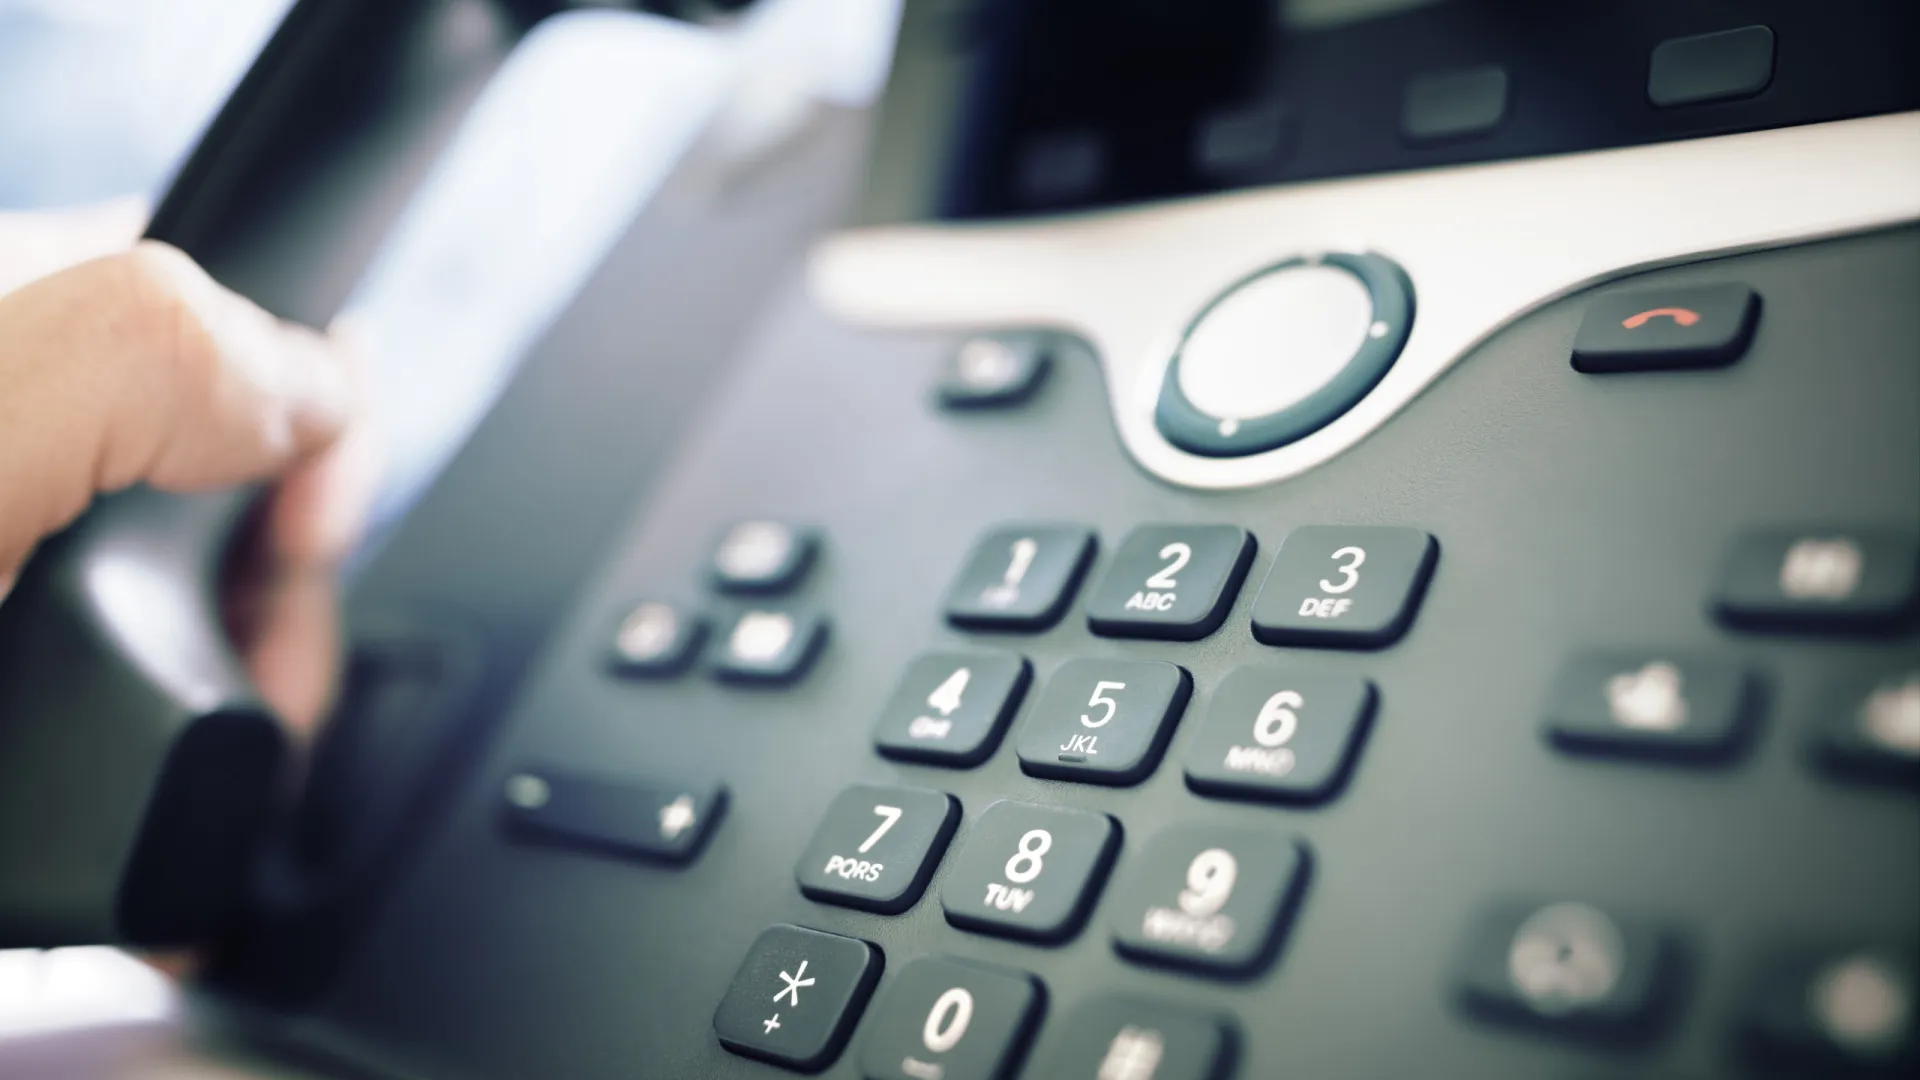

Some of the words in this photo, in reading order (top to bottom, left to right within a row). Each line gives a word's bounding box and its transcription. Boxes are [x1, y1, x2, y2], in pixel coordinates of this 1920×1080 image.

[1145, 542, 1191, 588] 2
[1319, 546, 1366, 594] 3
[1125, 593, 1177, 611] ABC
[1297, 597, 1353, 618] DEF
[926, 667, 972, 715] 4
[1080, 681, 1126, 728] 5
[1252, 690, 1304, 747] 6
[1059, 734, 1098, 754] JKL
[858, 805, 902, 853] 7
[824, 855, 884, 882] PQRS
[1004, 829, 1052, 883] 8
[983, 883, 1034, 913] TUV
[1180, 848, 1238, 915] 9
[922, 987, 974, 1053] 0
